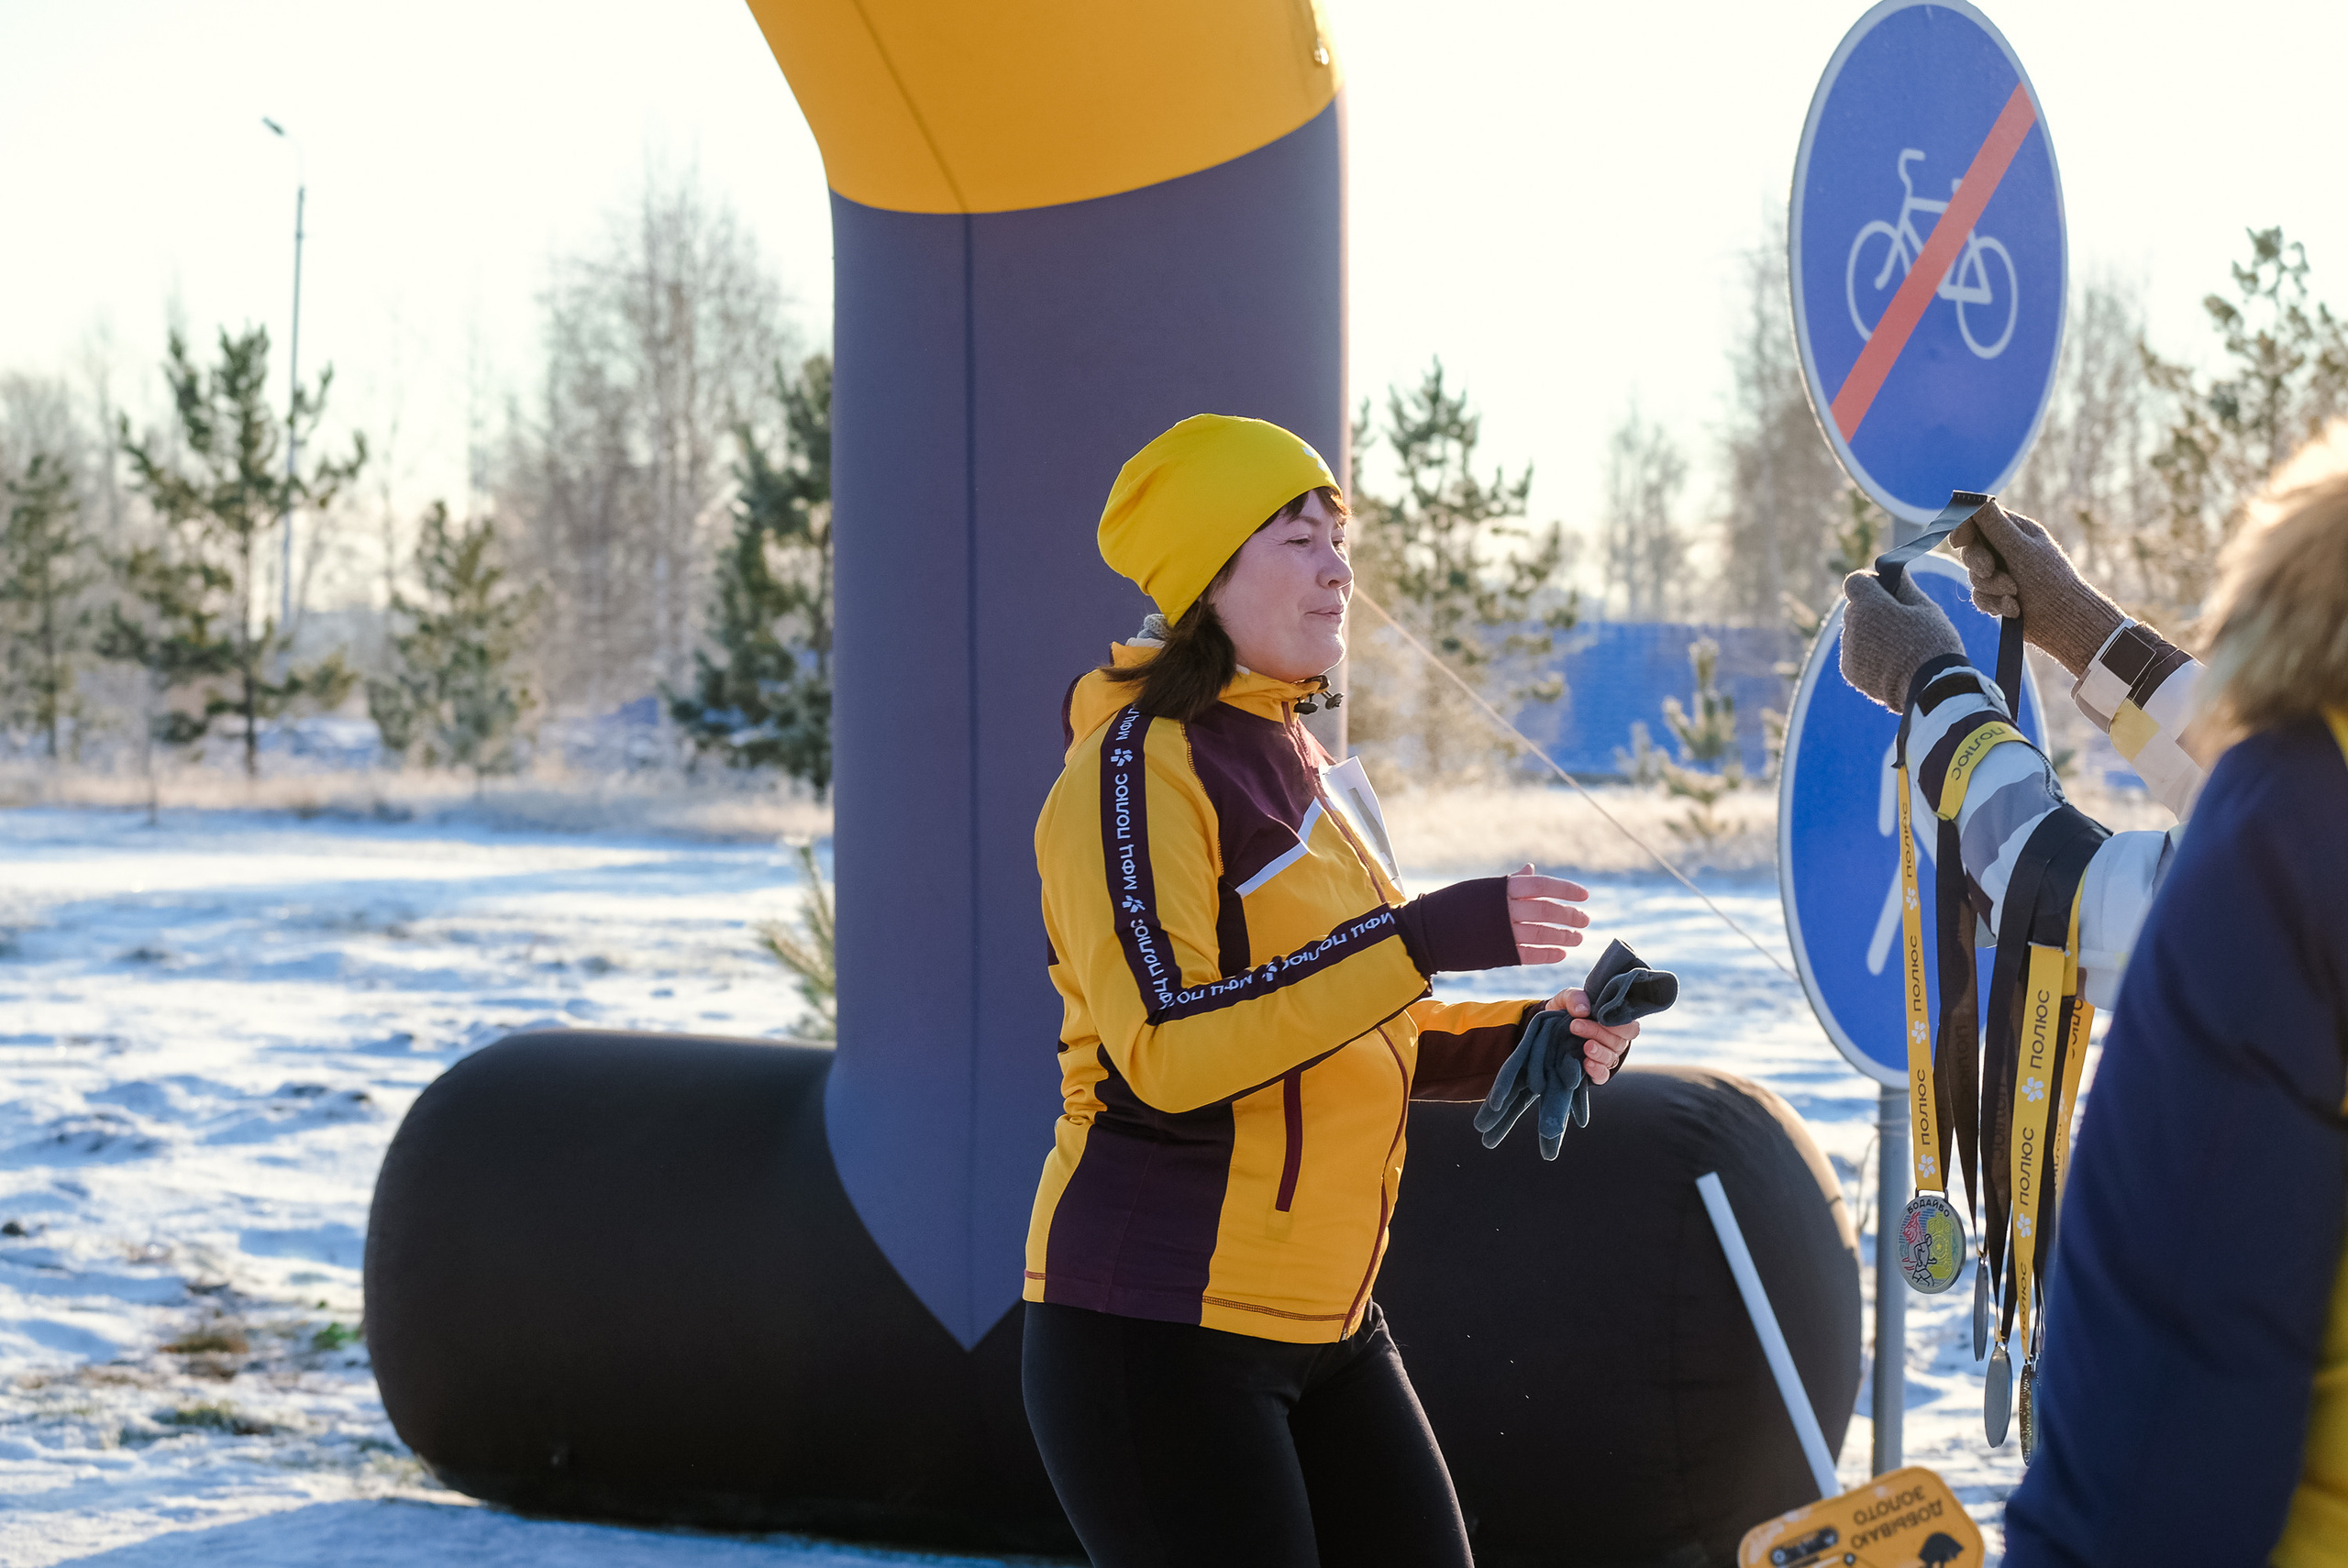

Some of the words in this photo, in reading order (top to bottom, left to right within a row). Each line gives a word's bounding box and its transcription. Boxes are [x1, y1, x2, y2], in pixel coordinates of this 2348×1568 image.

[1115, 715, 1139, 740] МФЦ
[1951, 726, 2007, 780] ПОЛЮС
[1115, 773, 1130, 839] ПОЛЮС
[1119, 844, 1137, 890] МФЦ
[1902, 802, 1912, 878] ПОЛЮС
[1130, 918, 1164, 983] ПОЛЮС
[1911, 935, 1922, 1012] ПОЛЮС
[1211, 974, 1253, 997] МФЦ
[2030, 989, 2050, 1069] ПОЛЮС
[1917, 1069, 1931, 1145] ПОЛЮС
[2019, 1127, 2034, 1207] ПОЛЮС
[1908, 1198, 1950, 1218] БОДАЙБО
[2020, 1262, 2028, 1340] ПОЛЮС
[1851, 1499, 1944, 1550] ДОБЫВАЮ
[1854, 1485, 1924, 1526] ЗОЛОТО
